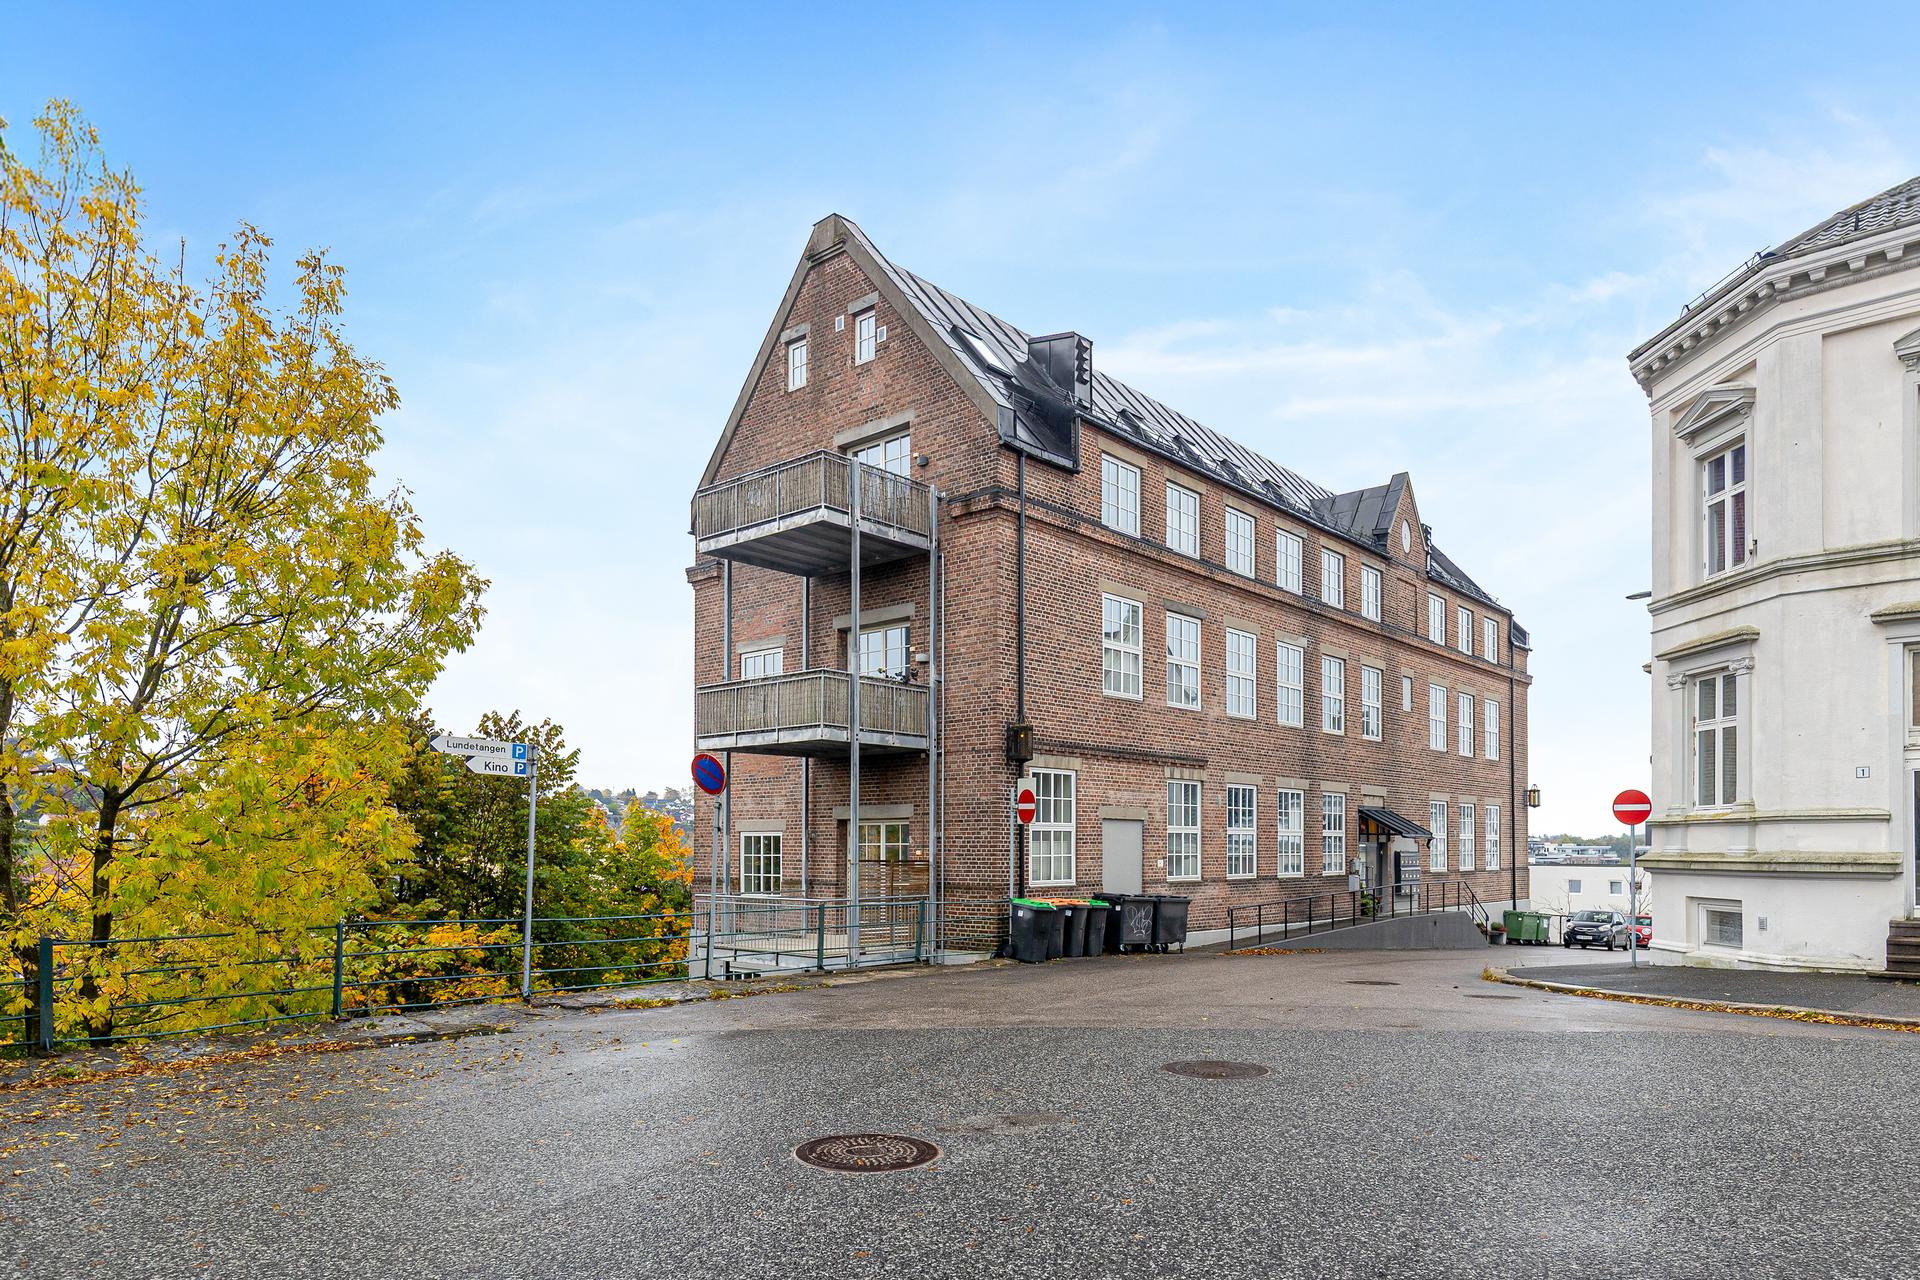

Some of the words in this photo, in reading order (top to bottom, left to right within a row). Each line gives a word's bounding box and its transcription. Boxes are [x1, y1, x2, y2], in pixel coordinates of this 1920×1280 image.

[446, 740, 506, 753] Lundetangen
[515, 747, 524, 757] P
[484, 761, 509, 772] Kino
[517, 764, 524, 773] P
